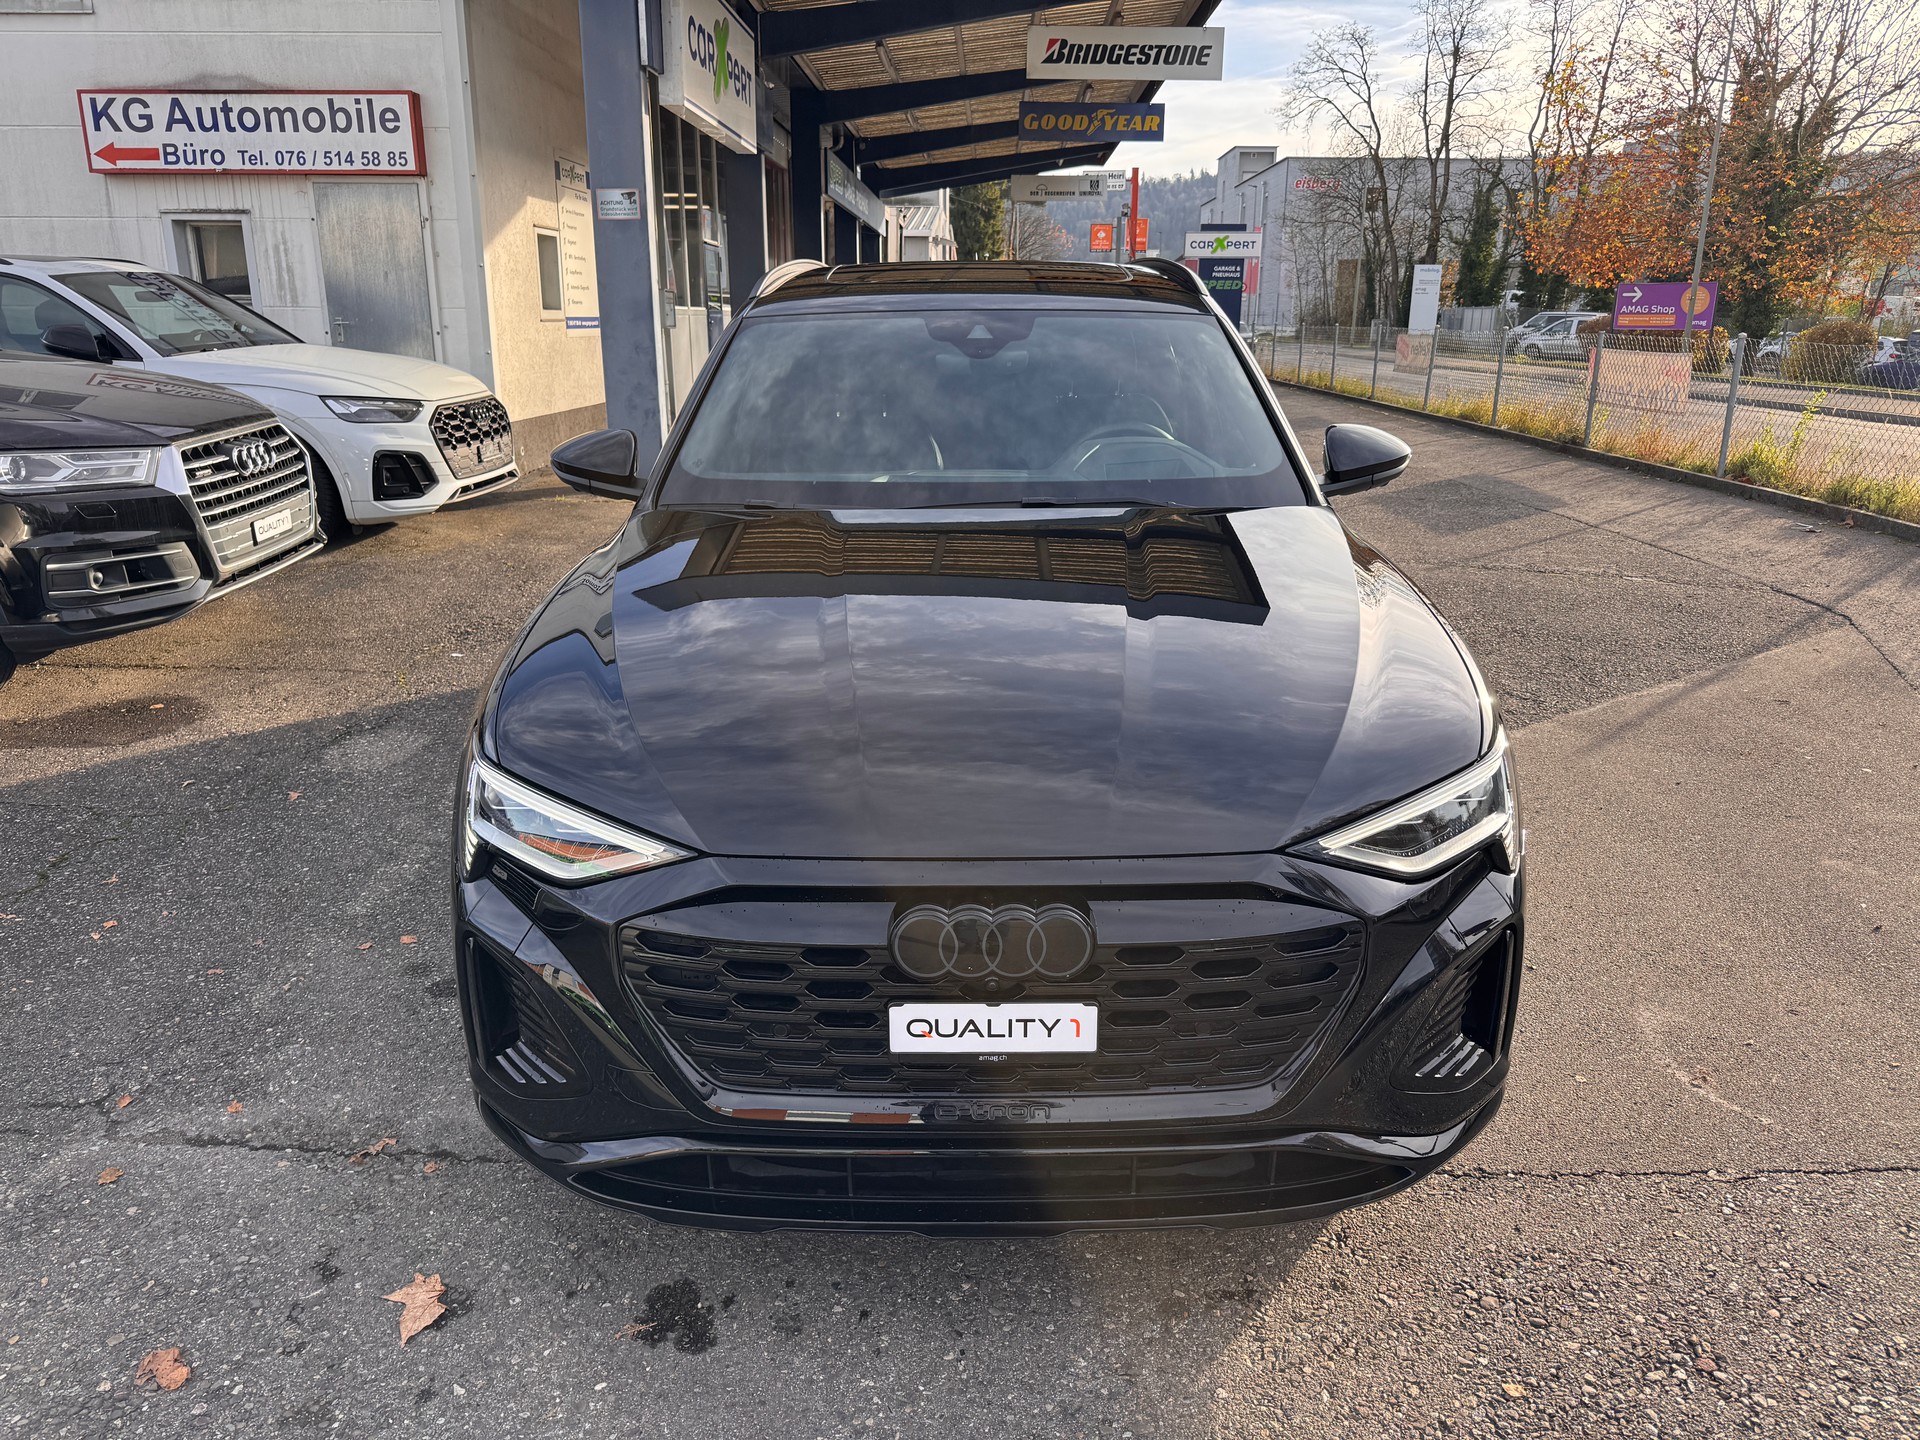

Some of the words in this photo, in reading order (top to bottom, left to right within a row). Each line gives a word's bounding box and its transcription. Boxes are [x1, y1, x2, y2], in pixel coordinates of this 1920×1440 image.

[1040, 38, 1213, 66] BRIDGESTONE
[89, 96, 155, 134] KG
[164, 97, 401, 134] Automobile
[162, 142, 226, 166] Büro
[237, 150, 269, 167] Tel.
[274, 150, 307, 167] 076
[312, 150, 317, 167] /
[323, 150, 355, 167] 514
[361, 151, 381, 167] 58
[387, 151, 408, 167] 85
[1620, 305, 1649, 314] AMAG
[1650, 305, 1676, 315] Shop
[258, 516, 285, 535] QUALITY
[906, 1018, 1062, 1038] QUALITY
[1069, 1018, 1081, 1038] 1
[978, 1054, 1008, 1062] amag.ch
[934, 1101, 1051, 1121] e-tron
